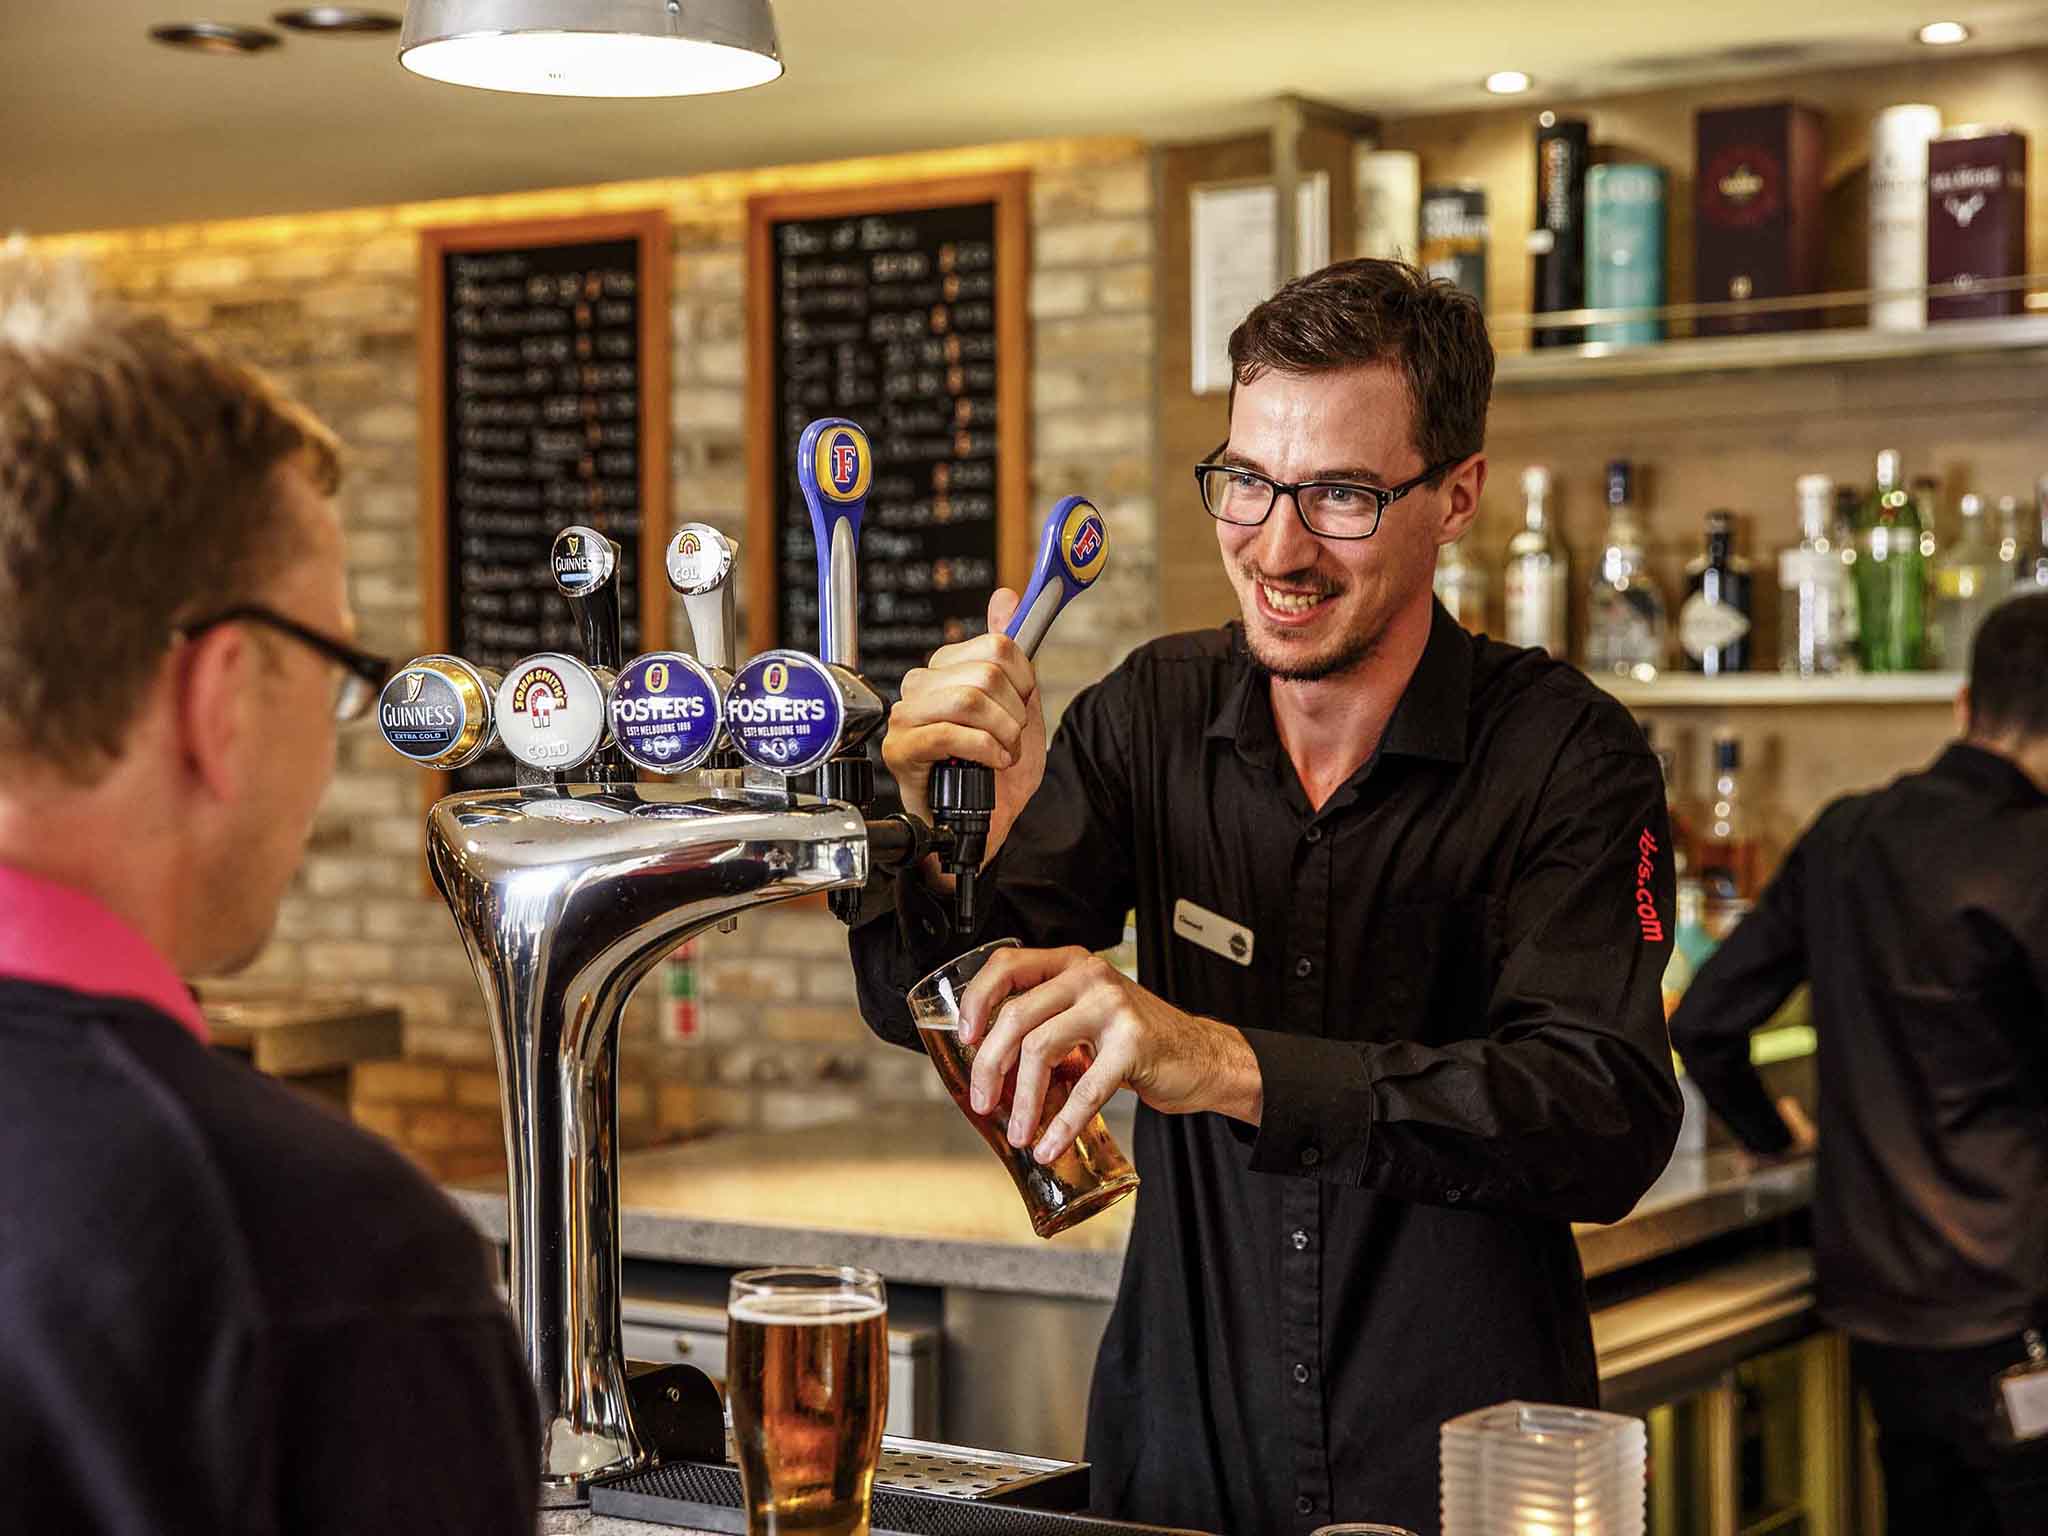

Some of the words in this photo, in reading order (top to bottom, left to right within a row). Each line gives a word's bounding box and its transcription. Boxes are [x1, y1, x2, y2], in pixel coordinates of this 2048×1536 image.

[834, 445, 856, 483] F
[1073, 521, 1102, 560] F
[555, 556, 600, 572] GUINNES
[674, 567, 702, 582] COL
[514, 672, 536, 711] JOHN
[382, 704, 455, 727] GUINNESS
[611, 695, 705, 722] FOSTER'S
[727, 695, 826, 723] FOSTER'S
[394, 732, 417, 741] EXTRA
[418, 732, 442, 740] COLD
[640, 723, 676, 736] MELBOURNE
[757, 725, 795, 737] MELBOURNE
[527, 742, 570, 760] COLD
